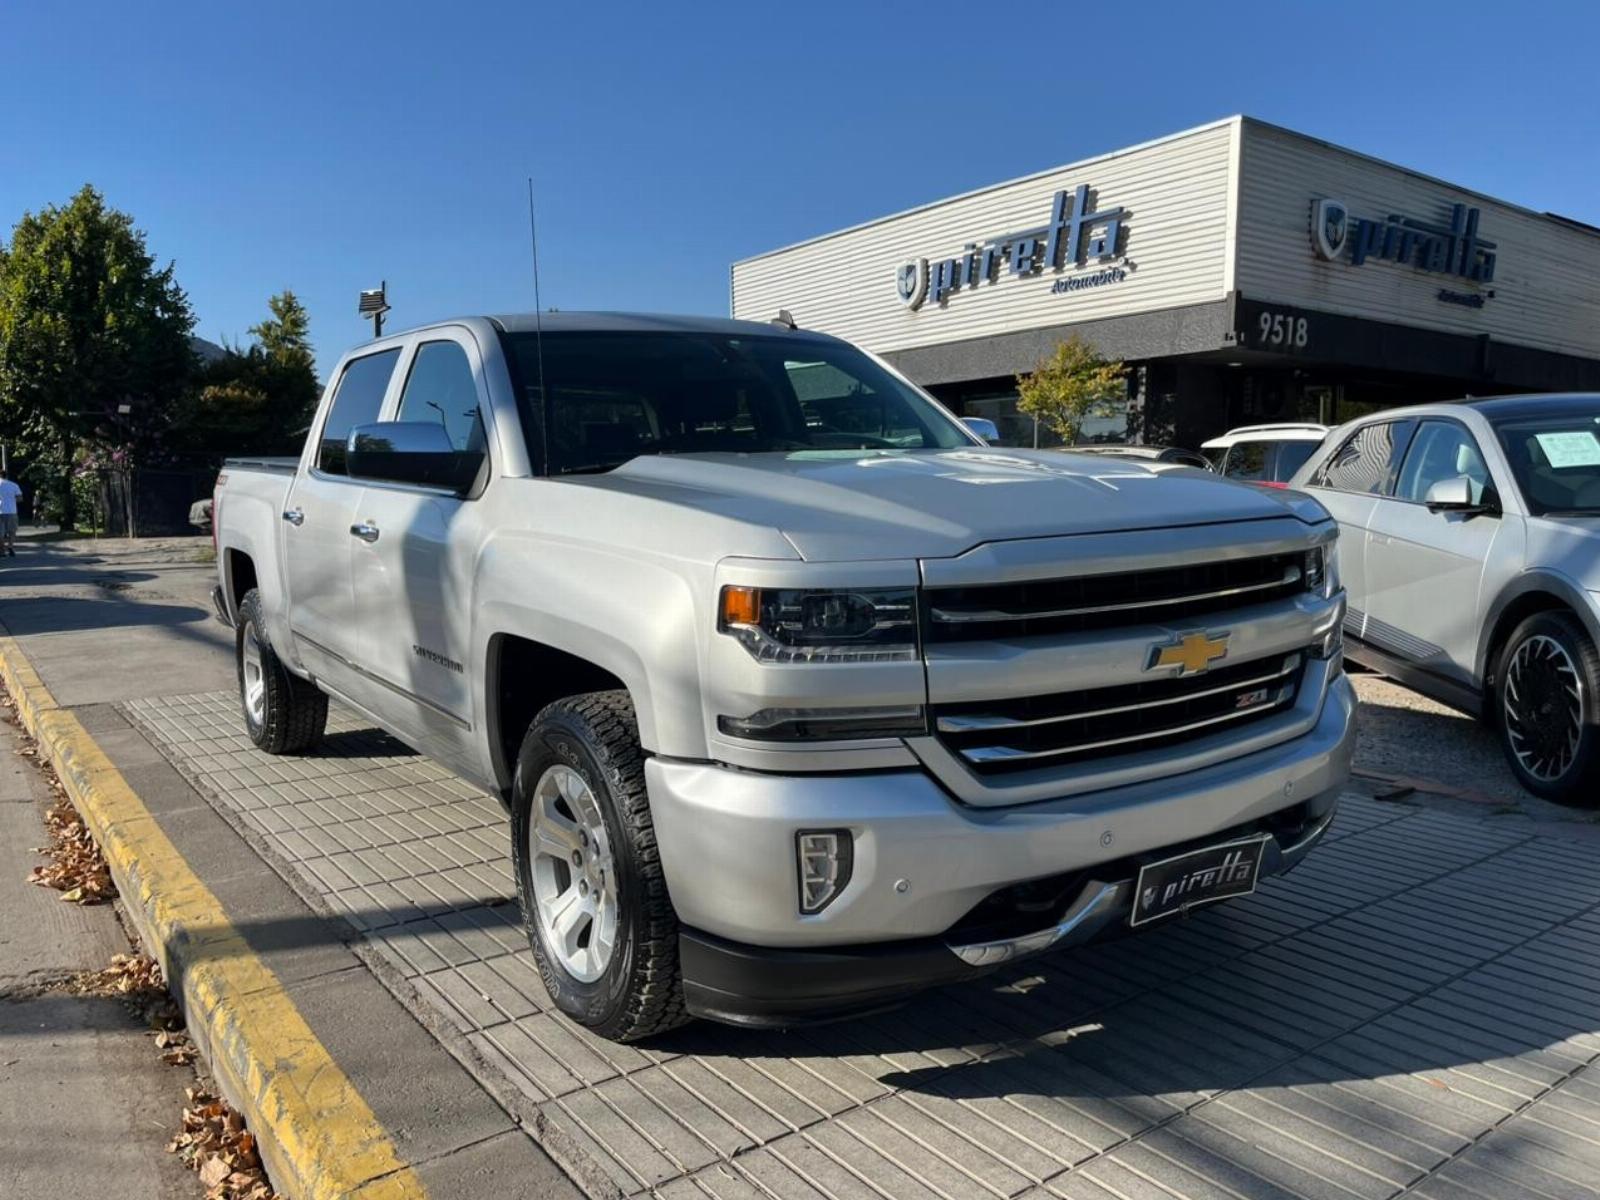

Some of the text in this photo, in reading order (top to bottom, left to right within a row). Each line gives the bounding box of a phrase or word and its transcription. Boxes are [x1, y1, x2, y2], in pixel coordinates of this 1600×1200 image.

[927, 184, 1124, 305] piretta
[1351, 203, 1497, 282] piretta
[1259, 312, 1307, 347] 9518
[1161, 851, 1253, 905] piretta
